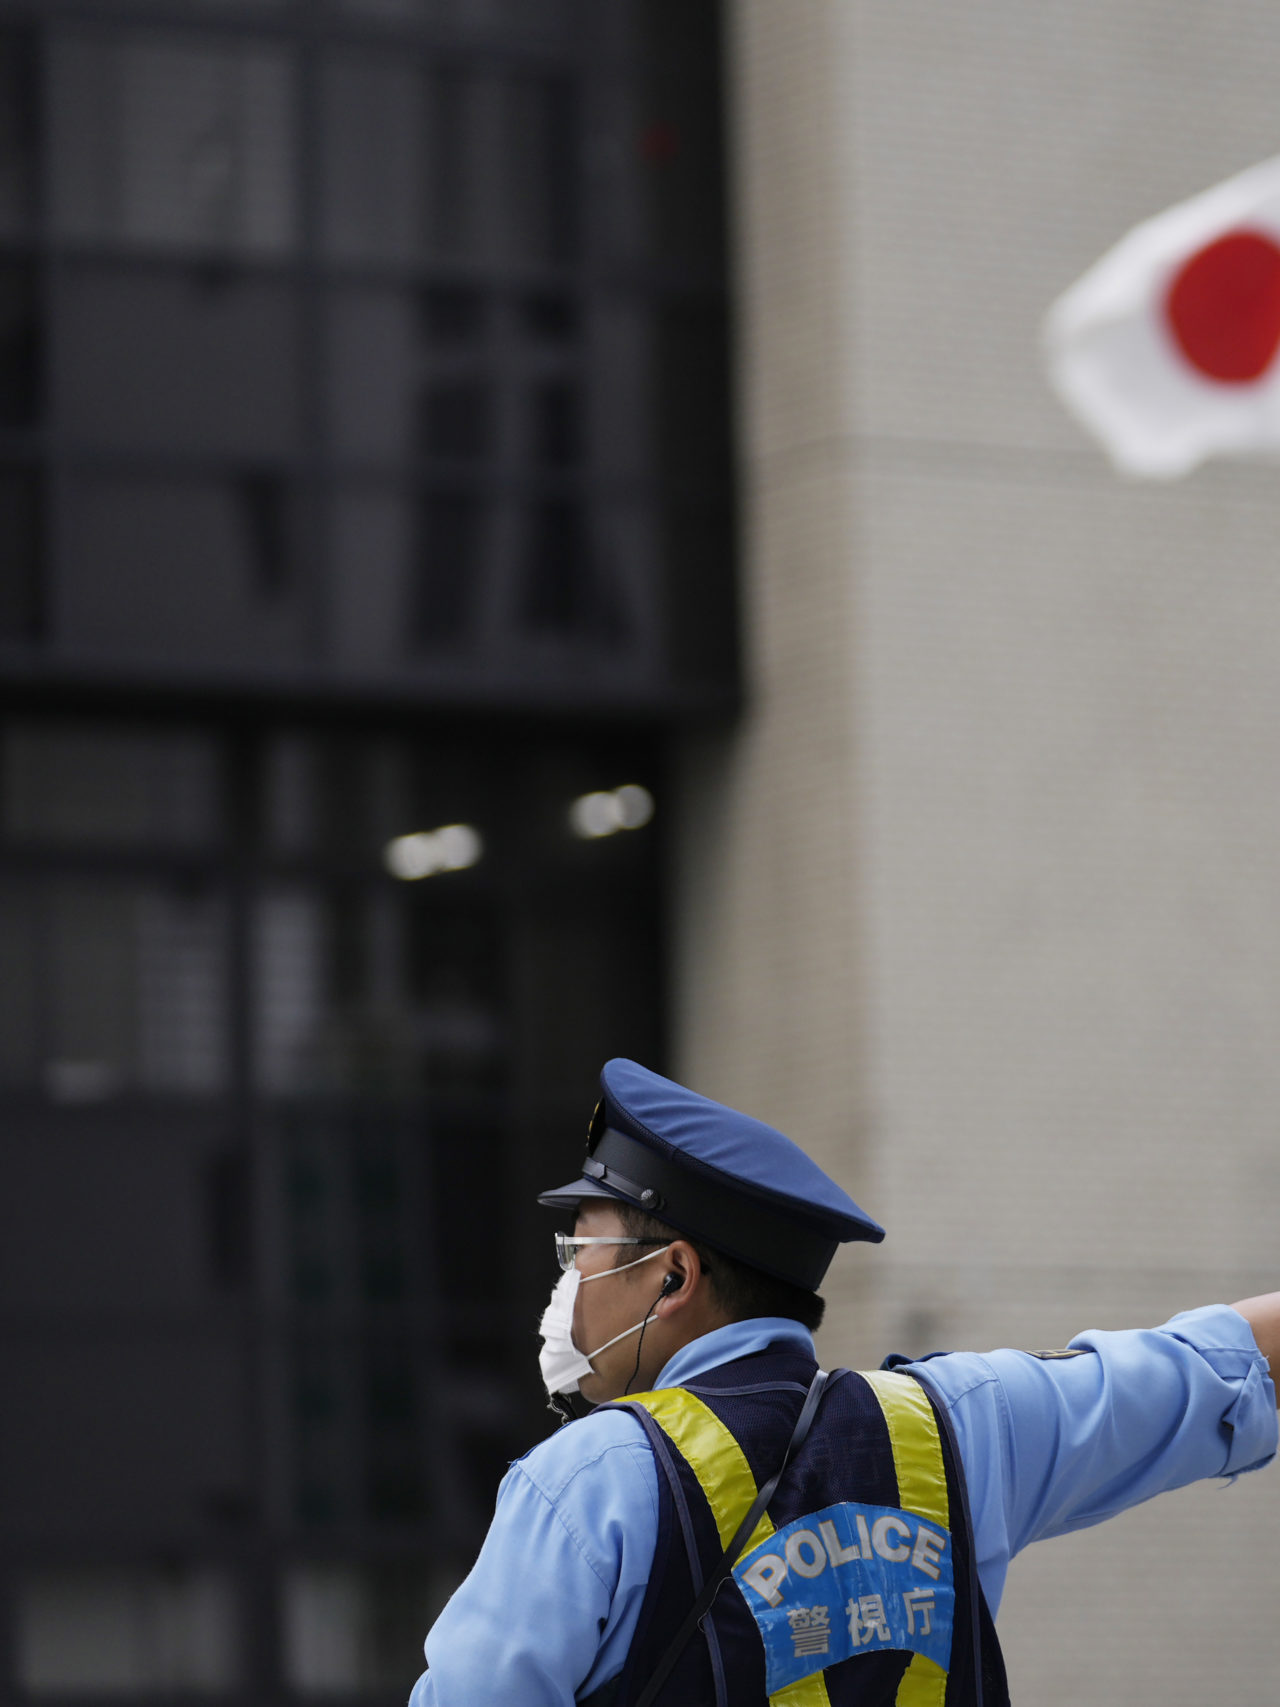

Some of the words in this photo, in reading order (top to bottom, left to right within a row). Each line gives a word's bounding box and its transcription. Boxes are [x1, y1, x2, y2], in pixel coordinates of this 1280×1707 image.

[742, 1514, 946, 1608] POLICE
[786, 1587, 936, 1658] 警視庁
